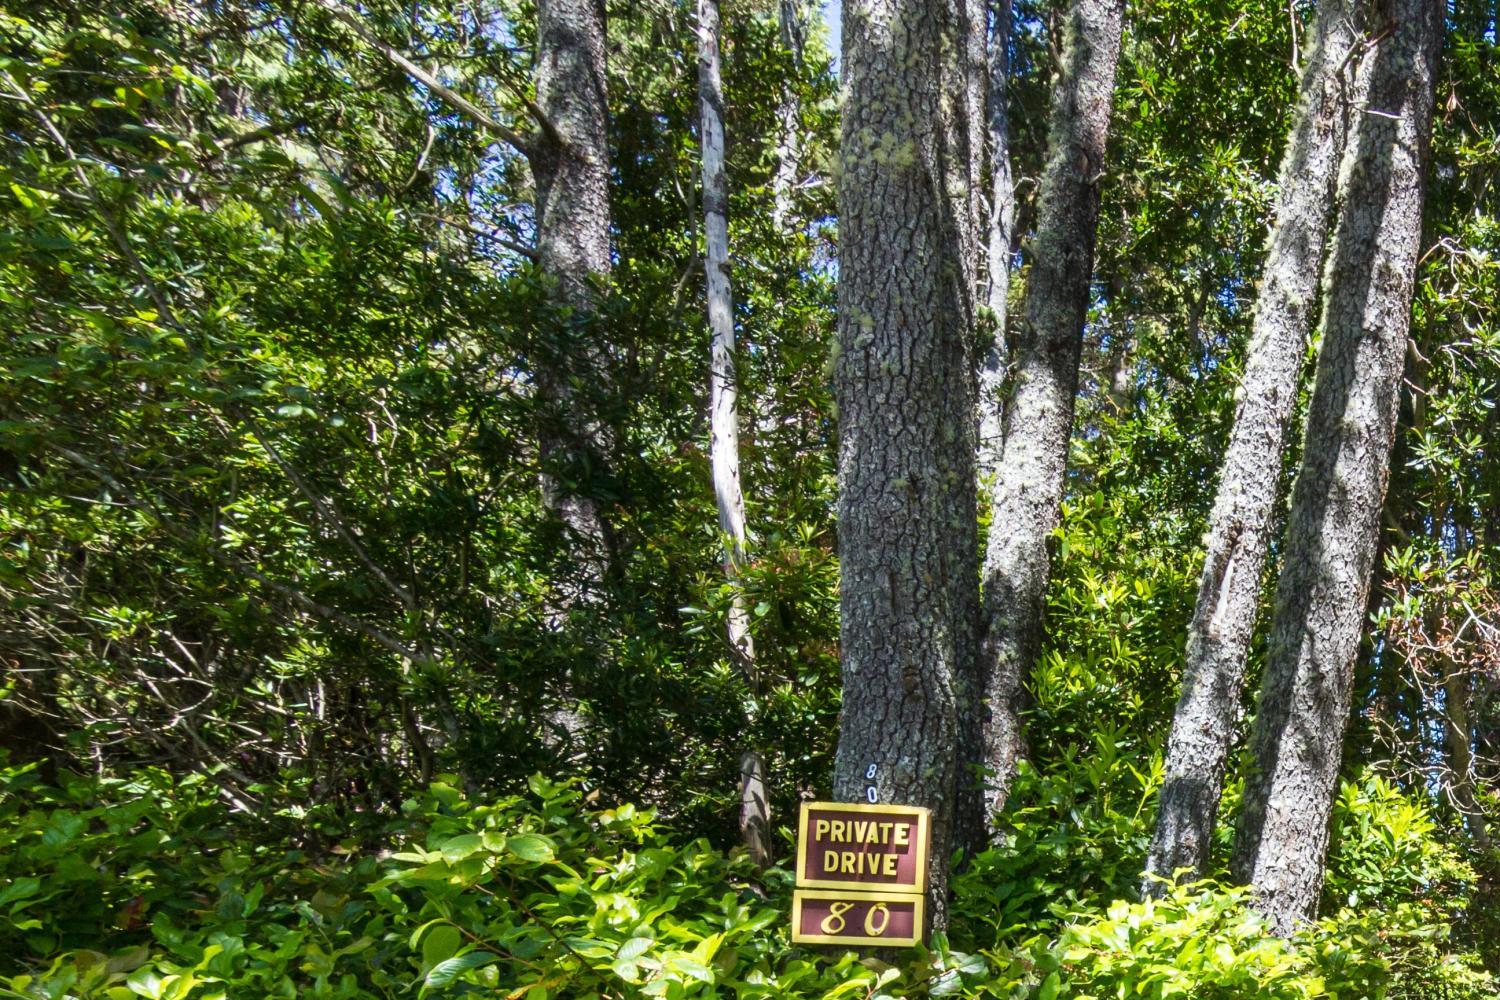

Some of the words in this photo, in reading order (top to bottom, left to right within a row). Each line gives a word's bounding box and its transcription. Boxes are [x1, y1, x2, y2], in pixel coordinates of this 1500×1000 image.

[815, 819, 910, 845] PRIVATE
[823, 850, 898, 876] DRIVE
[820, 902, 891, 937] 80
